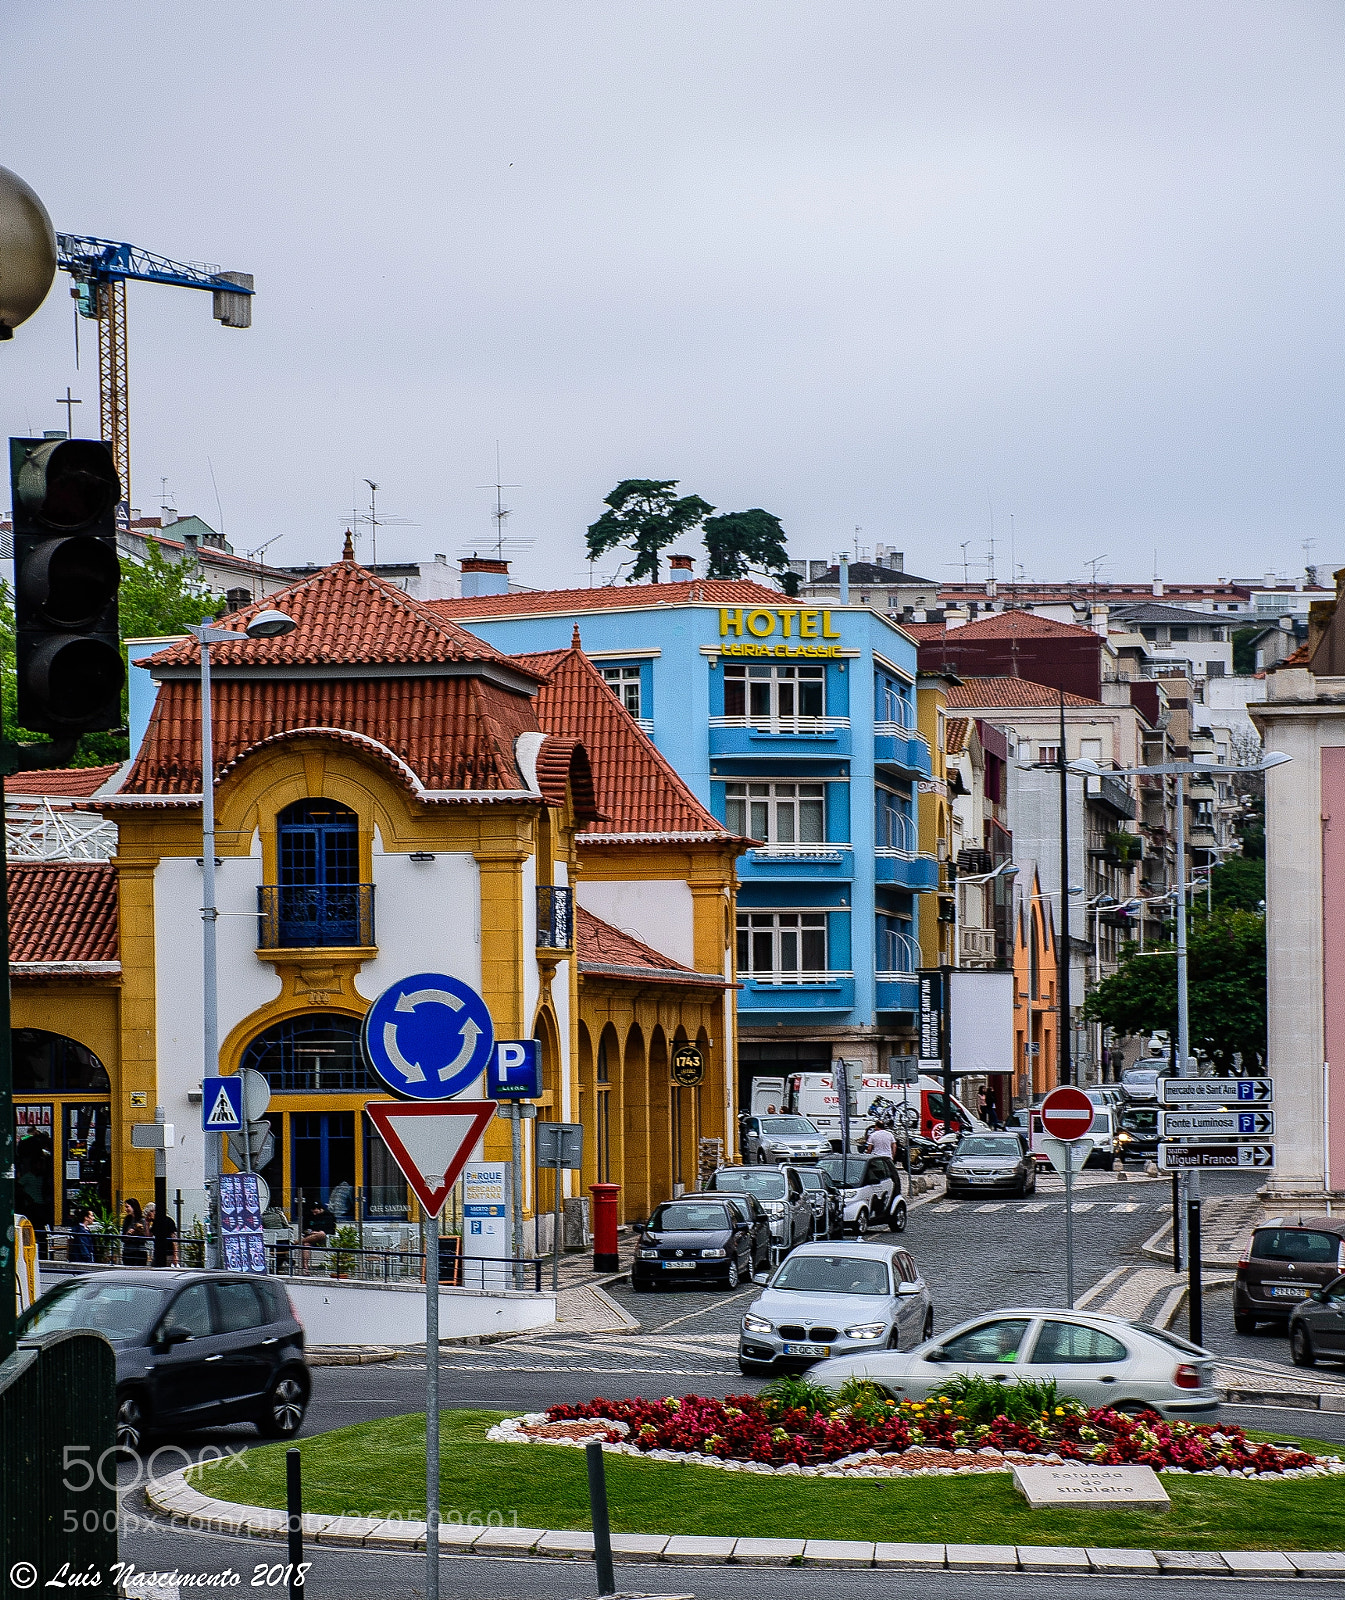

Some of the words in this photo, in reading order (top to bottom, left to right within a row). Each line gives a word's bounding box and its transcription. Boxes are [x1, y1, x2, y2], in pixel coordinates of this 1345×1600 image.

[719, 608, 841, 638] HOTEL
[721, 643, 771, 656] LEIRIA
[774, 644, 842, 658] CLASSIC
[921, 979, 931, 1012] SANT'ANA
[921, 1012, 931, 1023] DE
[921, 1023, 931, 1058] MERCADO
[498, 1043, 526, 1082] P
[676, 1056, 701, 1067] 1743
[1166, 1085, 1196, 1095] mercado
[1196, 1085, 1205, 1095] de
[1166, 1118, 1190, 1128] Fonte
[1192, 1117, 1234, 1128] Luminosa
[1166, 1154, 1200, 1167] Miguel
[1202, 1154, 1238, 1165] Franco
